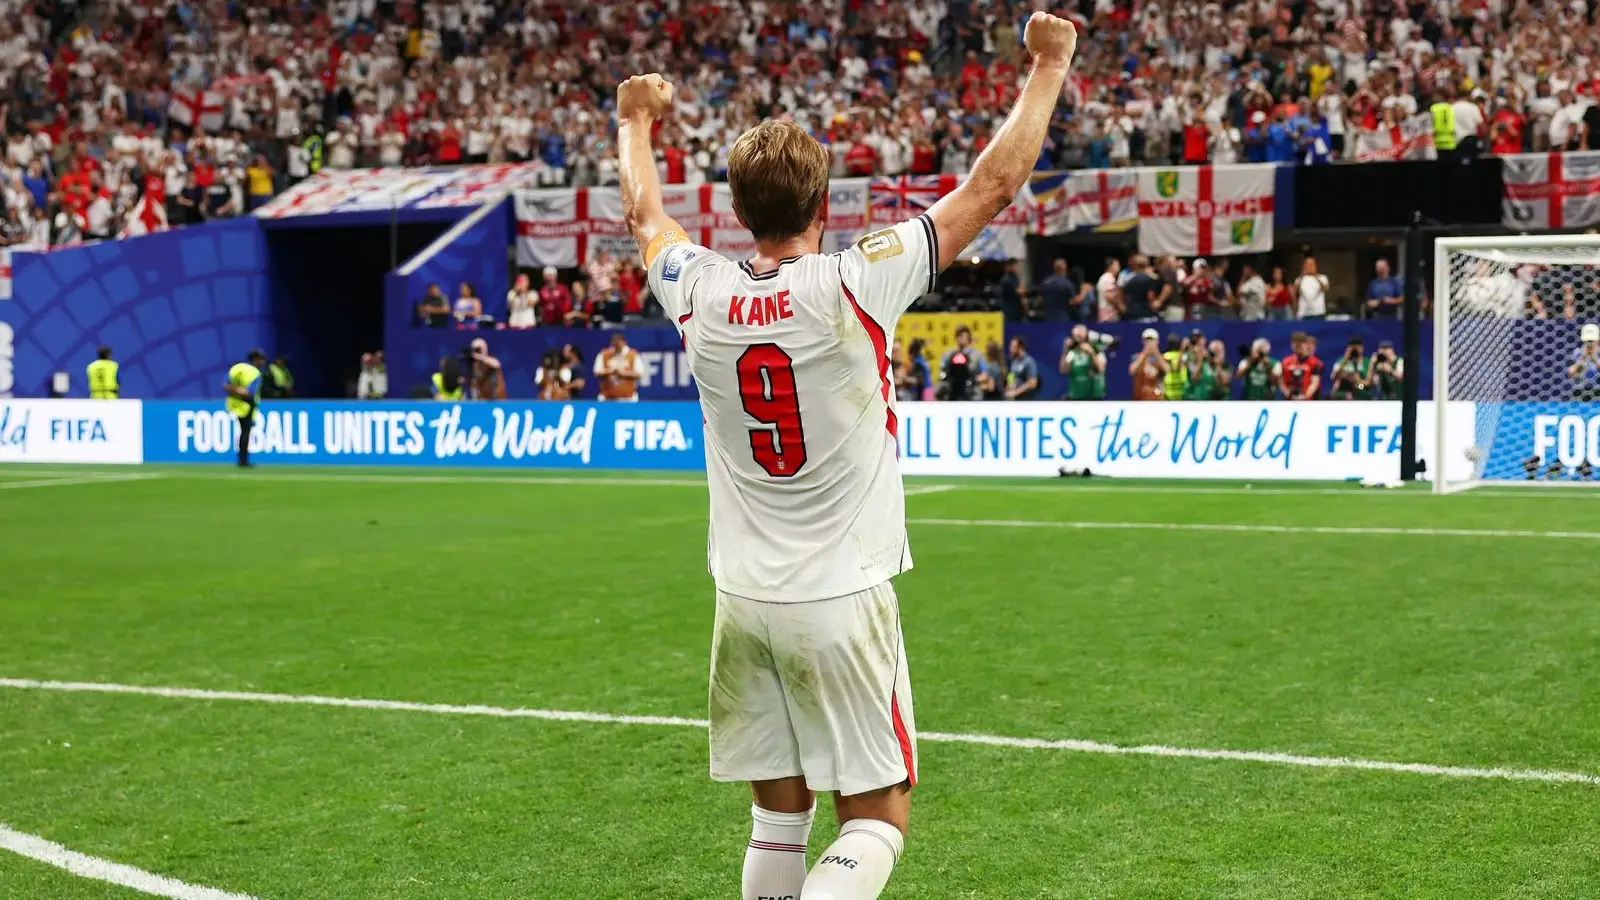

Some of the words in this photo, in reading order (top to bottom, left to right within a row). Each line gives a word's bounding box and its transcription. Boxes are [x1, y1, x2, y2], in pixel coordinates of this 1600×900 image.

[728, 289, 793, 326] KANE
[51, 418, 107, 443] FIFA
[324, 410, 425, 455] UNITES
[429, 404, 489, 459] the
[492, 404, 597, 464] World
[614, 419, 687, 450] FIFA
[736, 343, 807, 477] 9
[957, 416, 1077, 460] UNITES
[1090, 409, 1160, 463] the
[1170, 408, 1298, 469] World
[820, 855, 858, 870] ENG
